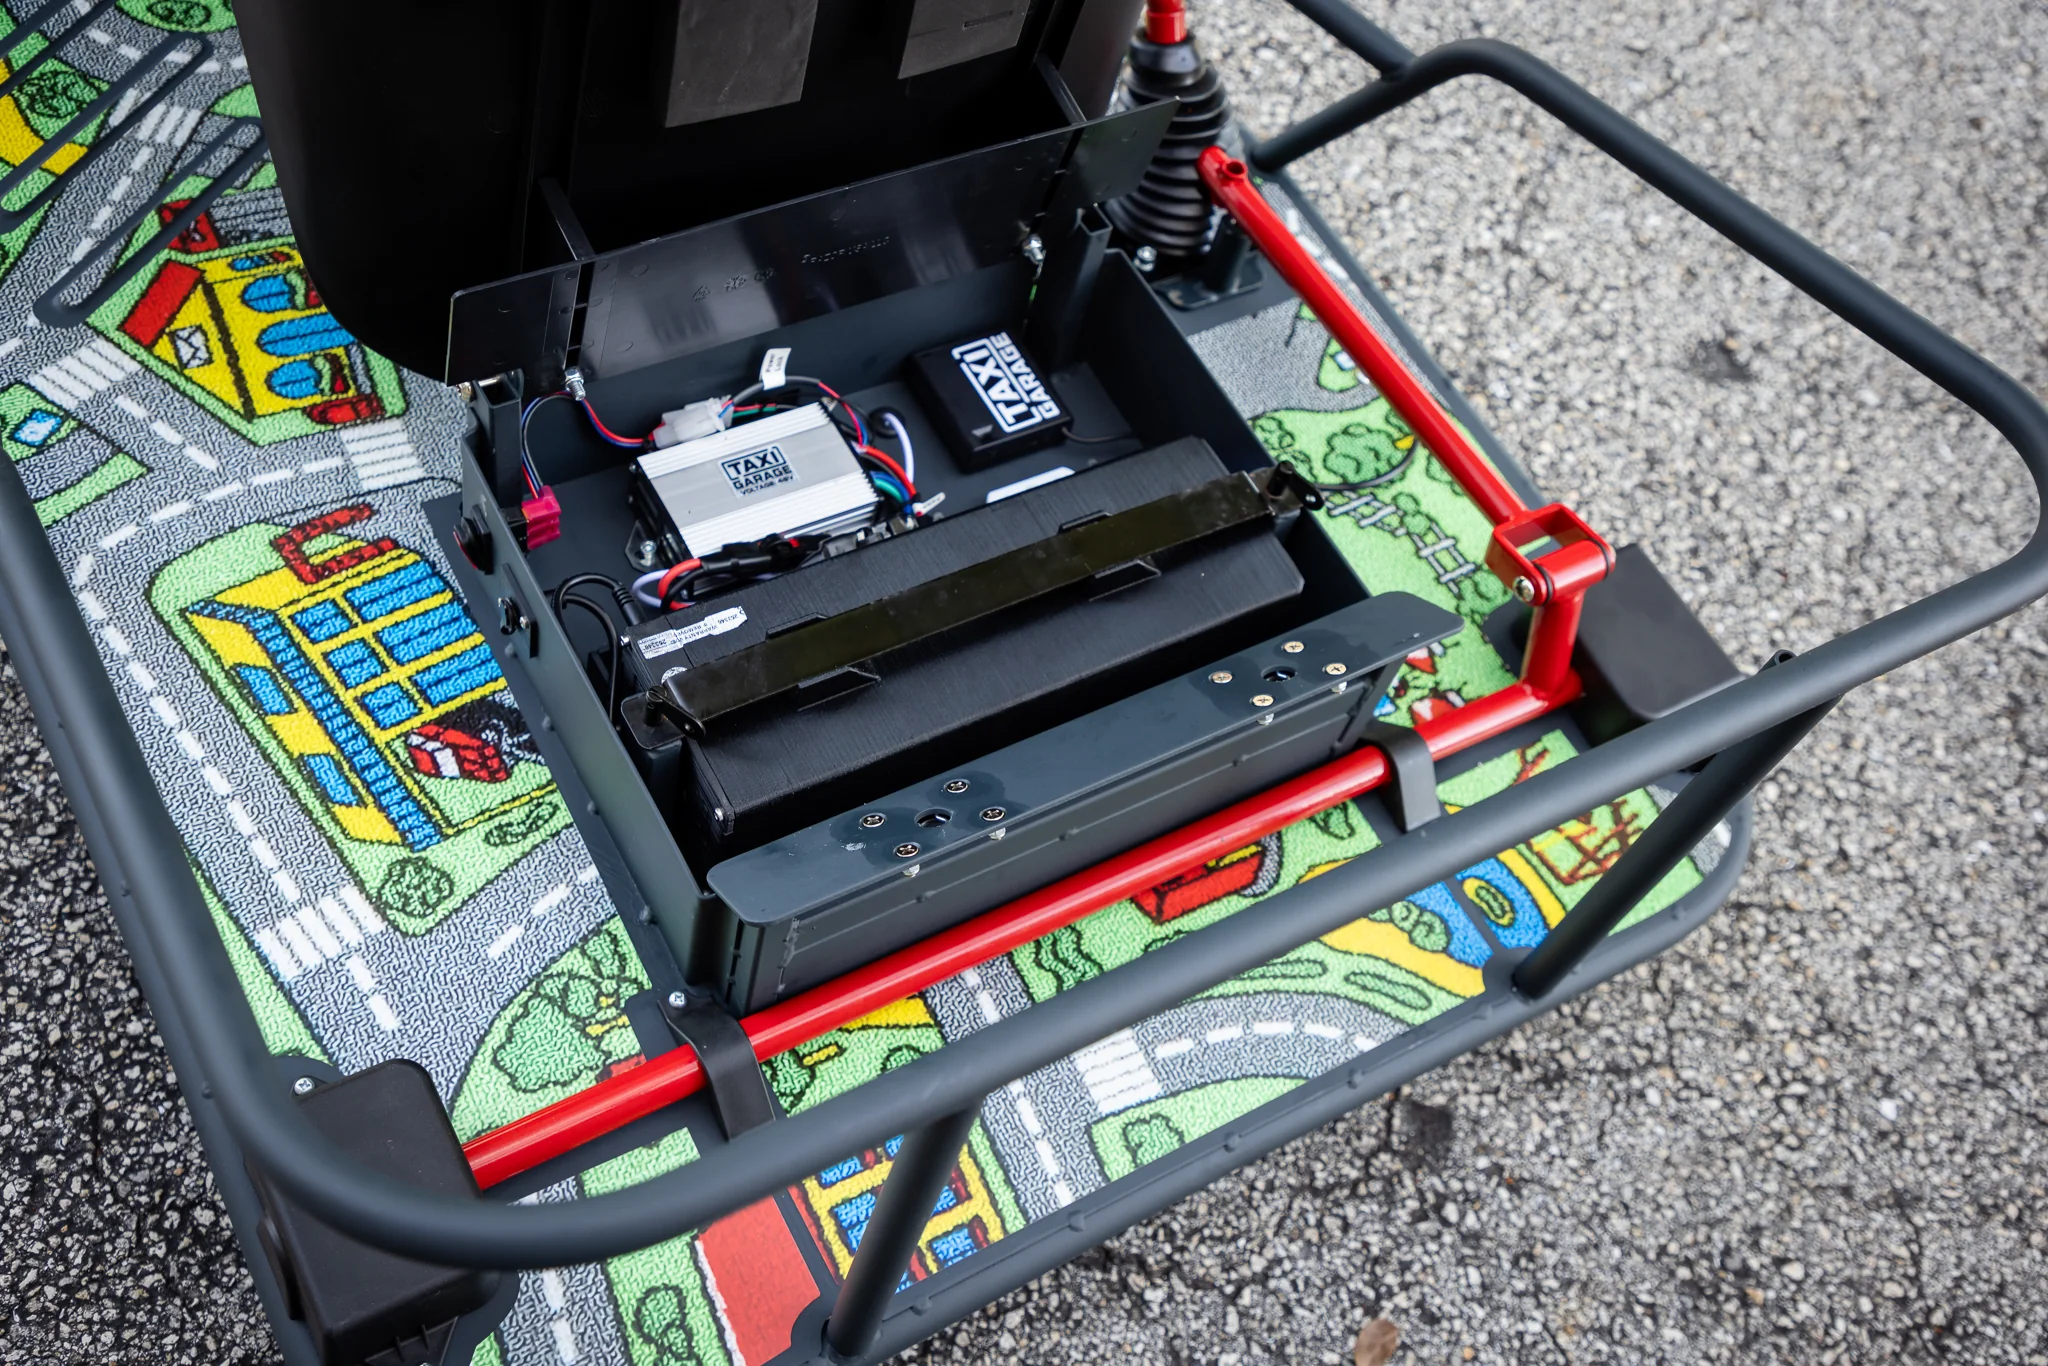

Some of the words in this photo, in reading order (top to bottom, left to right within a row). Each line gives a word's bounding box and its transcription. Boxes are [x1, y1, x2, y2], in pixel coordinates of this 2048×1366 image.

[962, 347, 1029, 425] TAXI
[989, 331, 1061, 420] GARAGE
[727, 450, 781, 476] TAXI
[732, 464, 793, 490] GARAGE
